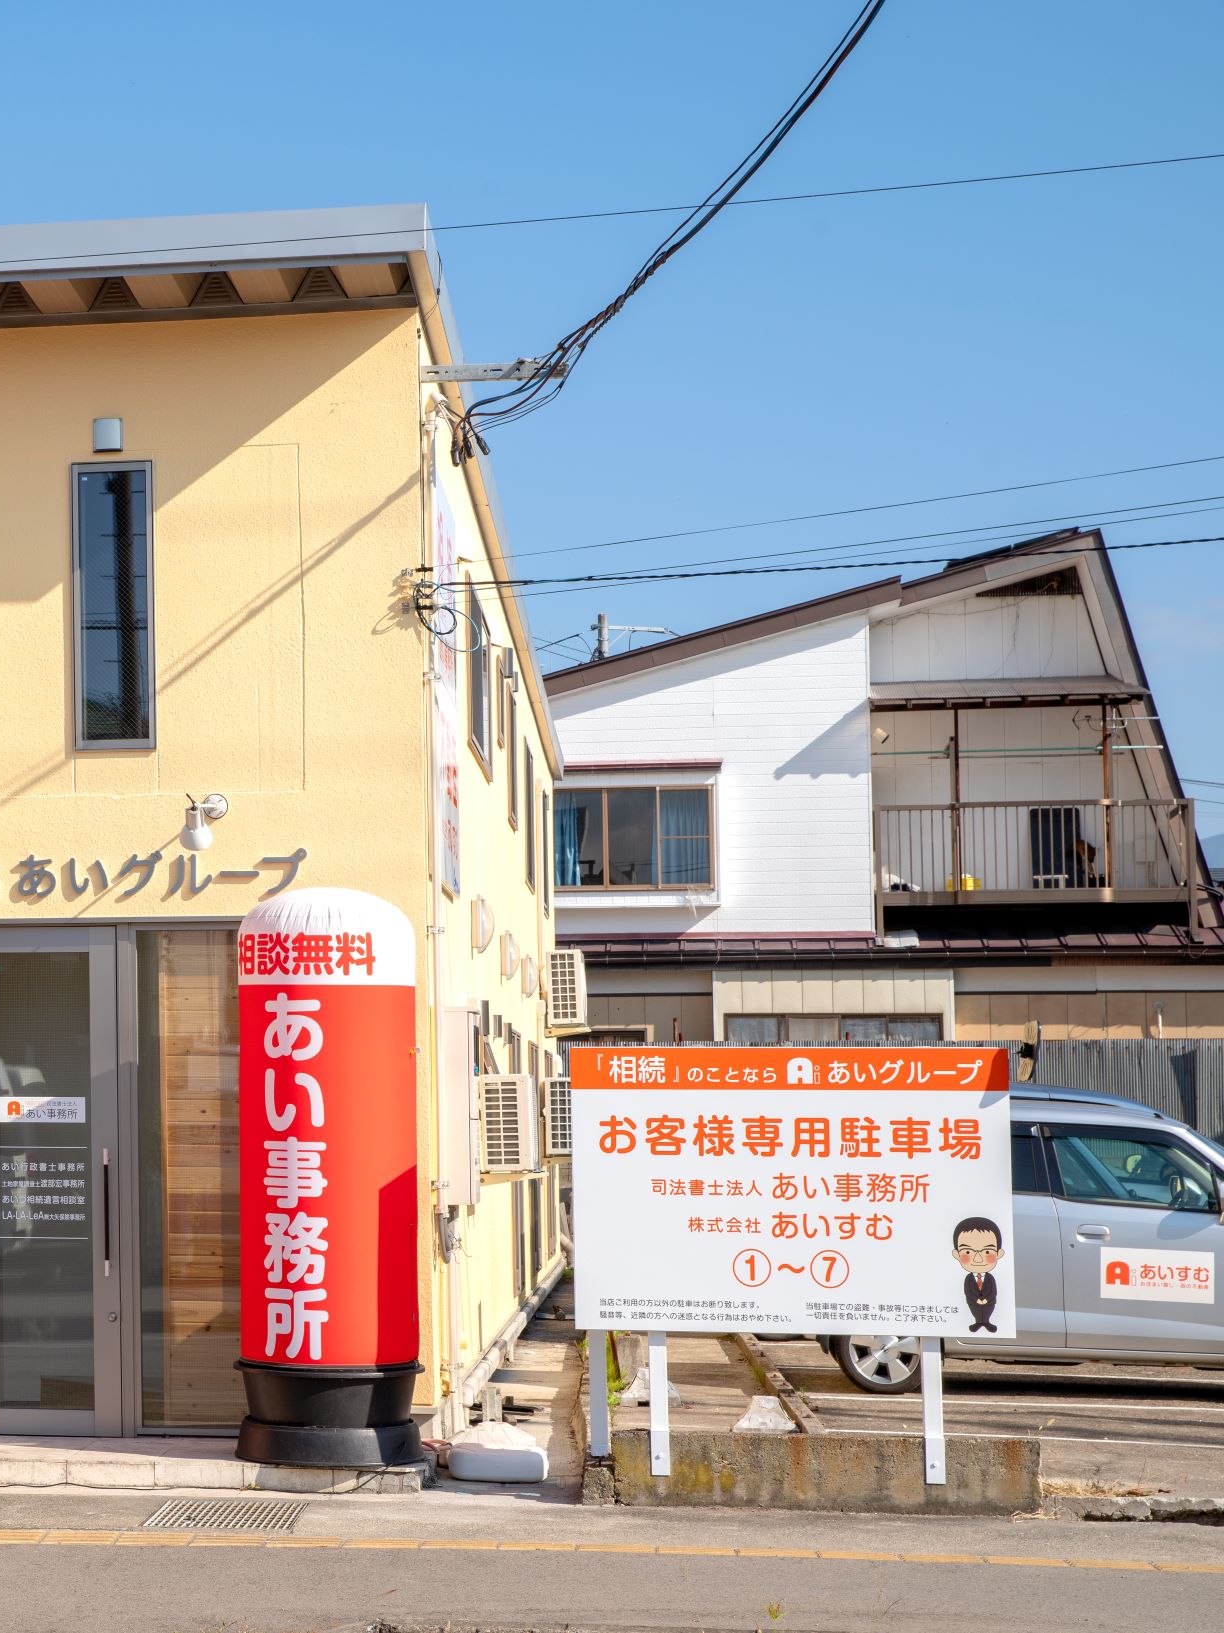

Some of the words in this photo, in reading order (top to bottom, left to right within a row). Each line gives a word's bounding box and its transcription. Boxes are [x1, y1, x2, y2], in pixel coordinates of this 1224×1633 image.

[17, 847, 308, 901] あいグループ
[238, 931, 376, 977] 相談無料
[828, 1059, 983, 1085] あいグループ
[25, 1108, 78, 1120] あい事務所
[598, 1113, 983, 1161] お客様専用駐車場
[1, 1162, 85, 1172] あい行政書士事務所
[263, 992, 330, 1361] あい事務所
[651, 1178, 763, 1198] 司法書士法人
[771, 1172, 931, 1204] あい事務所
[688, 1216, 762, 1235] 株式会社
[771, 1211, 894, 1241] あいすむ
[1140, 1264, 1210, 1283] あいすむ
[599, 1298, 761, 1309] 当店ご利用の方以外の駐車はお断り致します。
[806, 1302, 959, 1314] 当駐車場での盗難・事故等につきましては
[806, 1312, 948, 1323] 一切責任を負いません。ご了承下さい。
